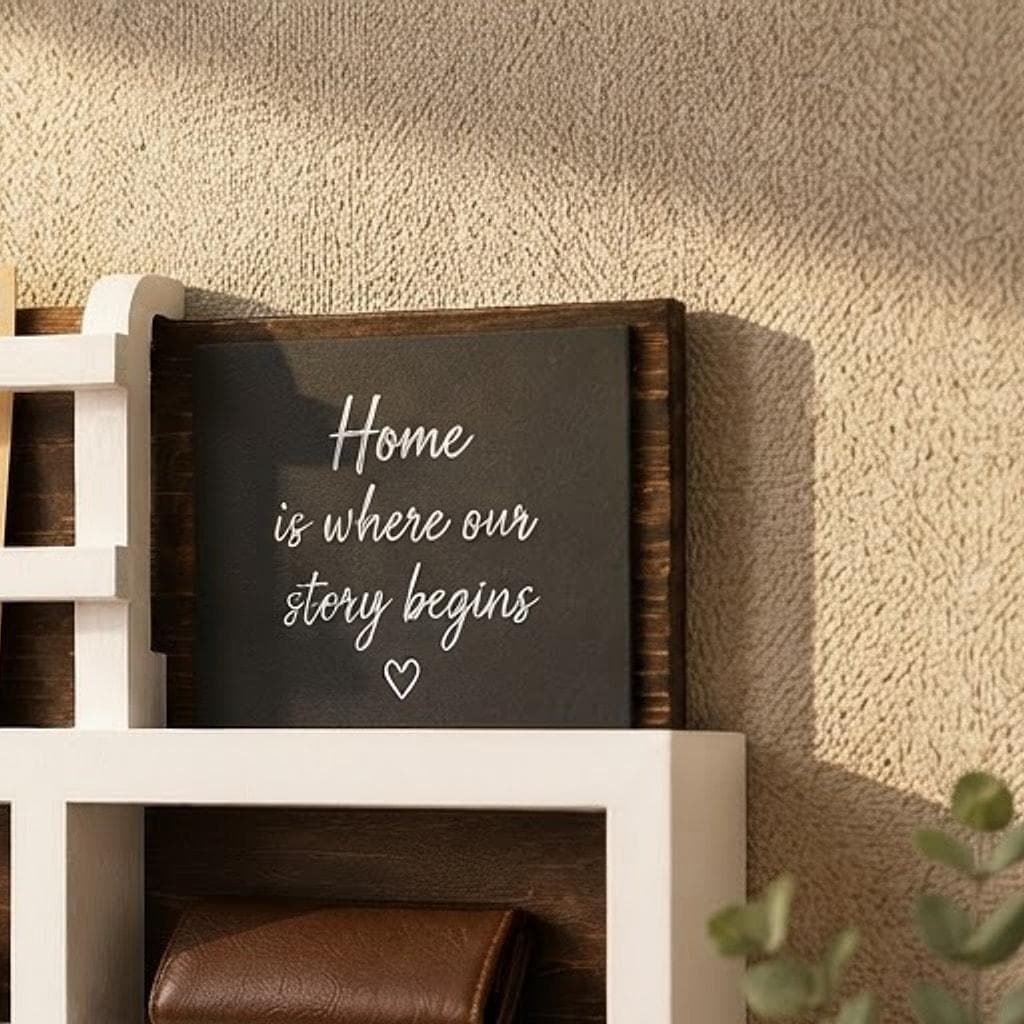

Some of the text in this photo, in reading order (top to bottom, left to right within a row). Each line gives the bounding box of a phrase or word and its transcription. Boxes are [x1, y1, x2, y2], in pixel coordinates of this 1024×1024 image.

[329, 393, 475, 476] Home
[274, 483, 539, 548] is where our
[283, 561, 541, 652] story begins
